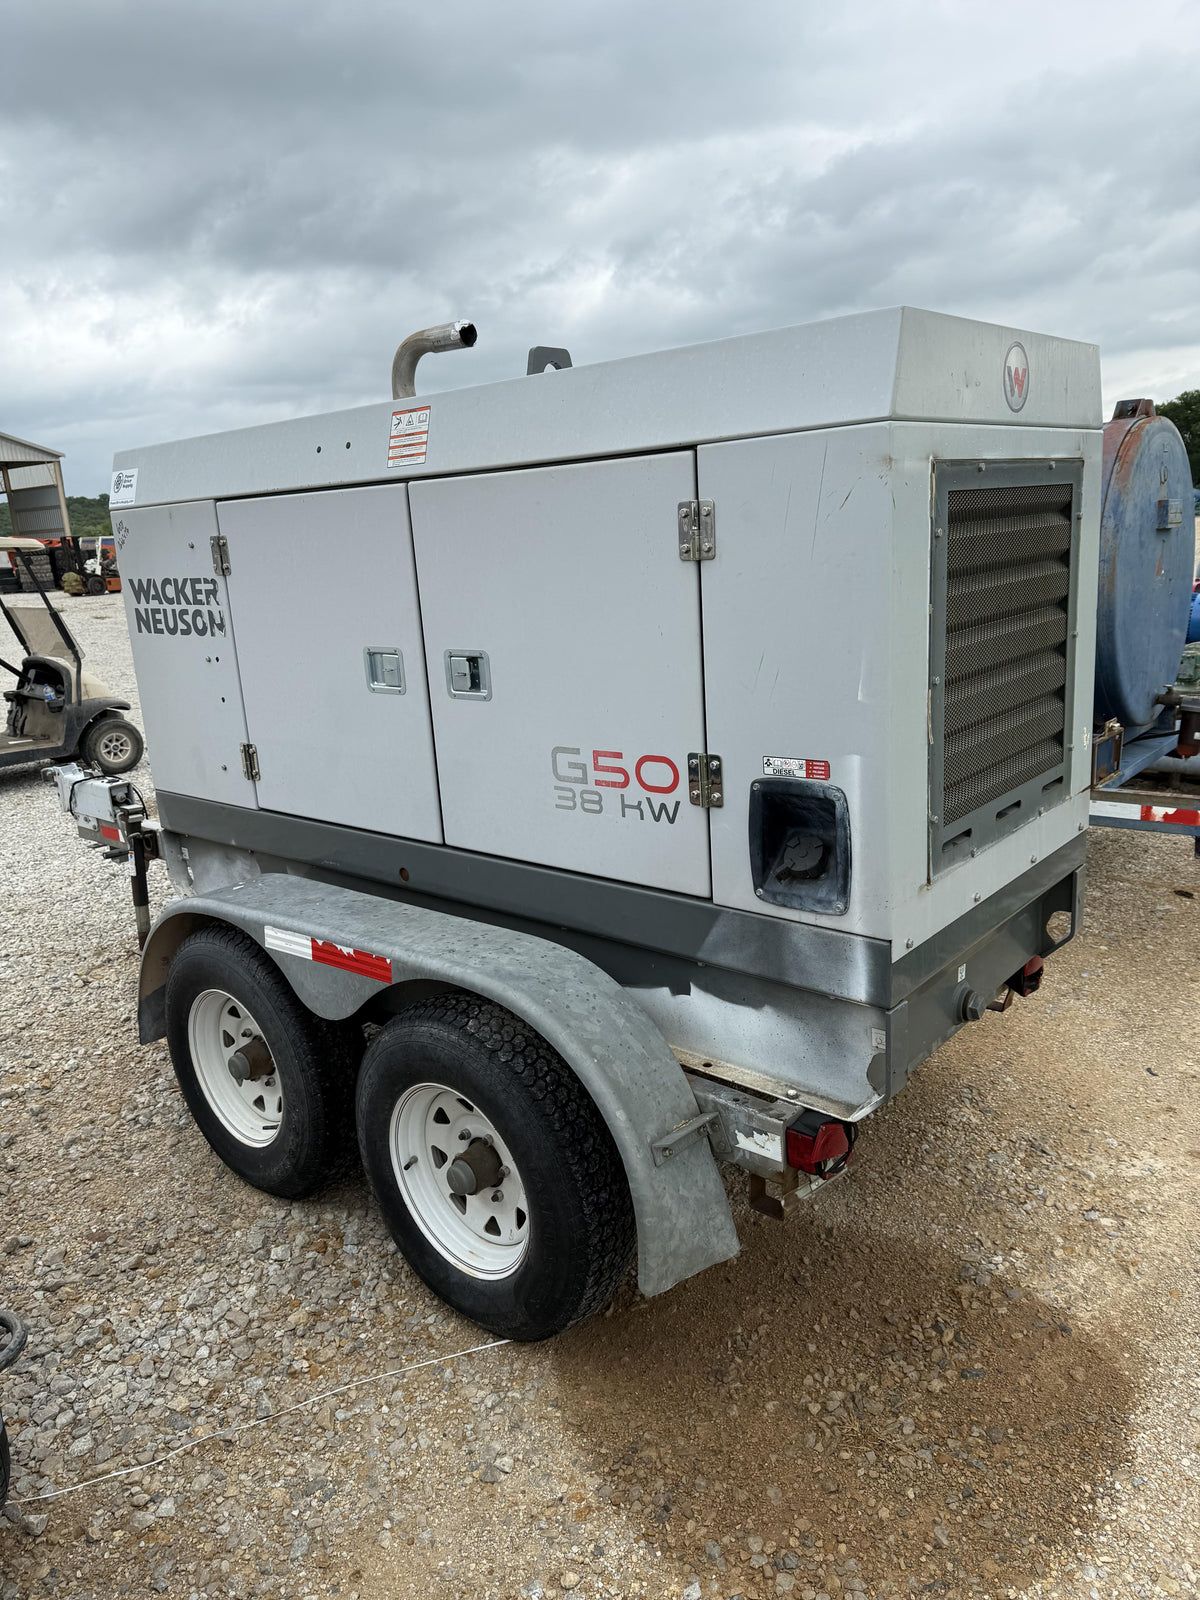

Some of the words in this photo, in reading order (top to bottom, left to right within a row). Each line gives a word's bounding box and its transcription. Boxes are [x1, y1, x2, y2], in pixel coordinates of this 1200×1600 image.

[127, 577, 220, 606] WACKER
[134, 607, 226, 637] NEUSON
[551, 746, 680, 795] G50
[773, 768, 796, 776] DIESEL
[553, 785, 604, 814] 38
